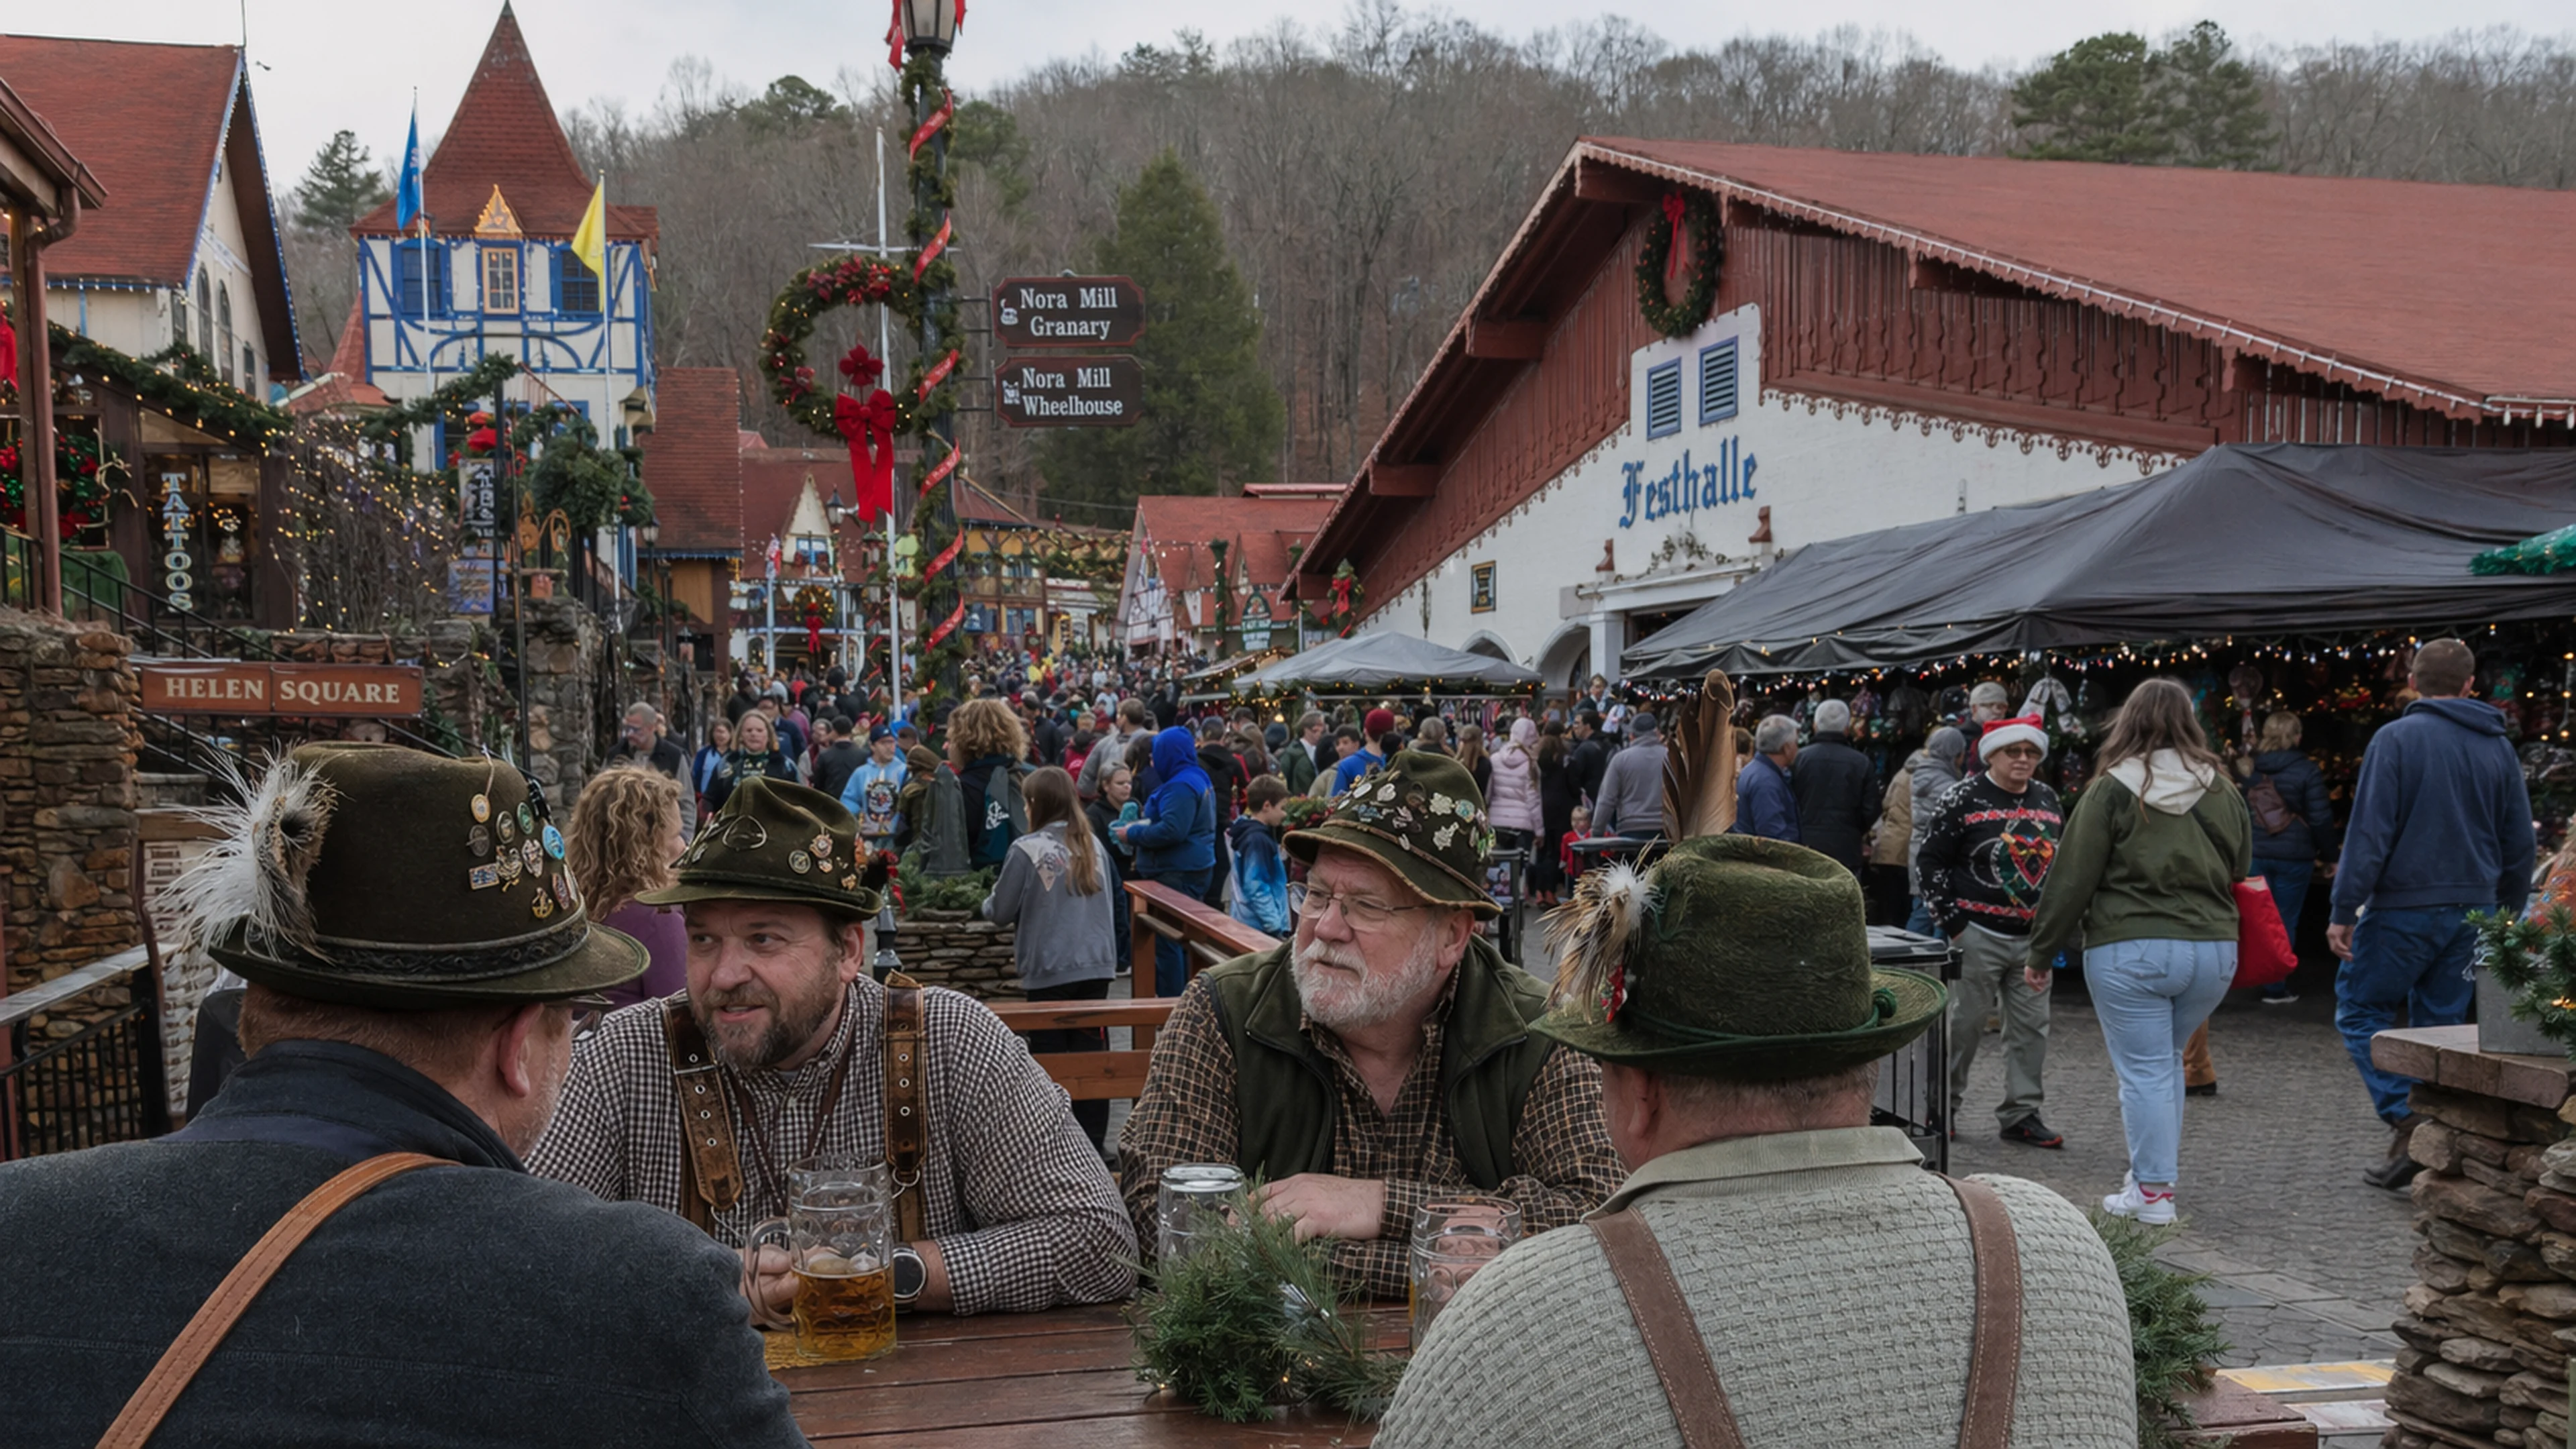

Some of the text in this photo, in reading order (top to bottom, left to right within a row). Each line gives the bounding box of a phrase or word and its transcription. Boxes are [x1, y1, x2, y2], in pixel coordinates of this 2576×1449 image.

[1020, 287, 1118, 309] Nora Mill
[1030, 315, 1111, 340] Granary
[1022, 368, 1111, 388] Nora Mill
[1022, 395, 1123, 416] Wheelhouse
[1619, 435, 1758, 529] Festhalle
[161, 472, 193, 612] TATTOOS
[165, 677, 400, 704] HELEN SQUARE
